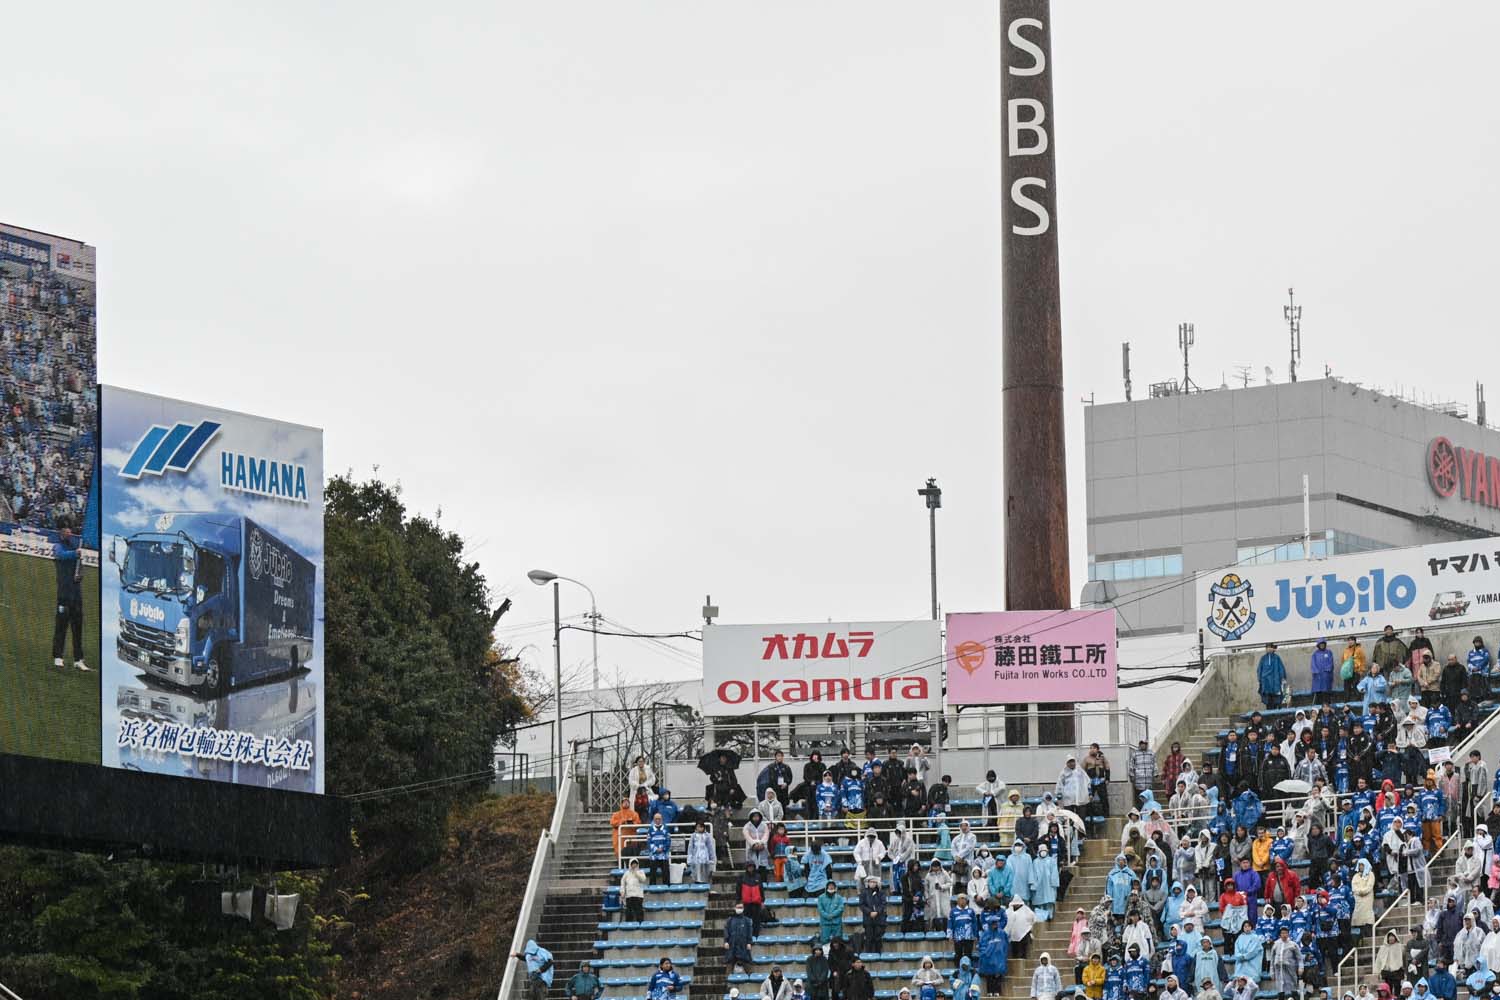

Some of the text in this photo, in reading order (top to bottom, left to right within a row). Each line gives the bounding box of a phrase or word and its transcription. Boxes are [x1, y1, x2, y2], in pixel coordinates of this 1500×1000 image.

[1007, 17, 1050, 236] SBS
[221, 451, 307, 500] HAMANA
[1265, 568, 1417, 622] Júbilo
[1317, 616, 1368, 631] IWATA
[762, 631, 875, 660] オカムラ
[994, 643, 1107, 667] 藤田鐵工所
[994, 670, 1019, 680] Fujita
[1022, 669, 1039, 679] Iron
[1042, 669, 1069, 679] Works
[118, 719, 314, 768] 浜名梱包輸送株式会社
